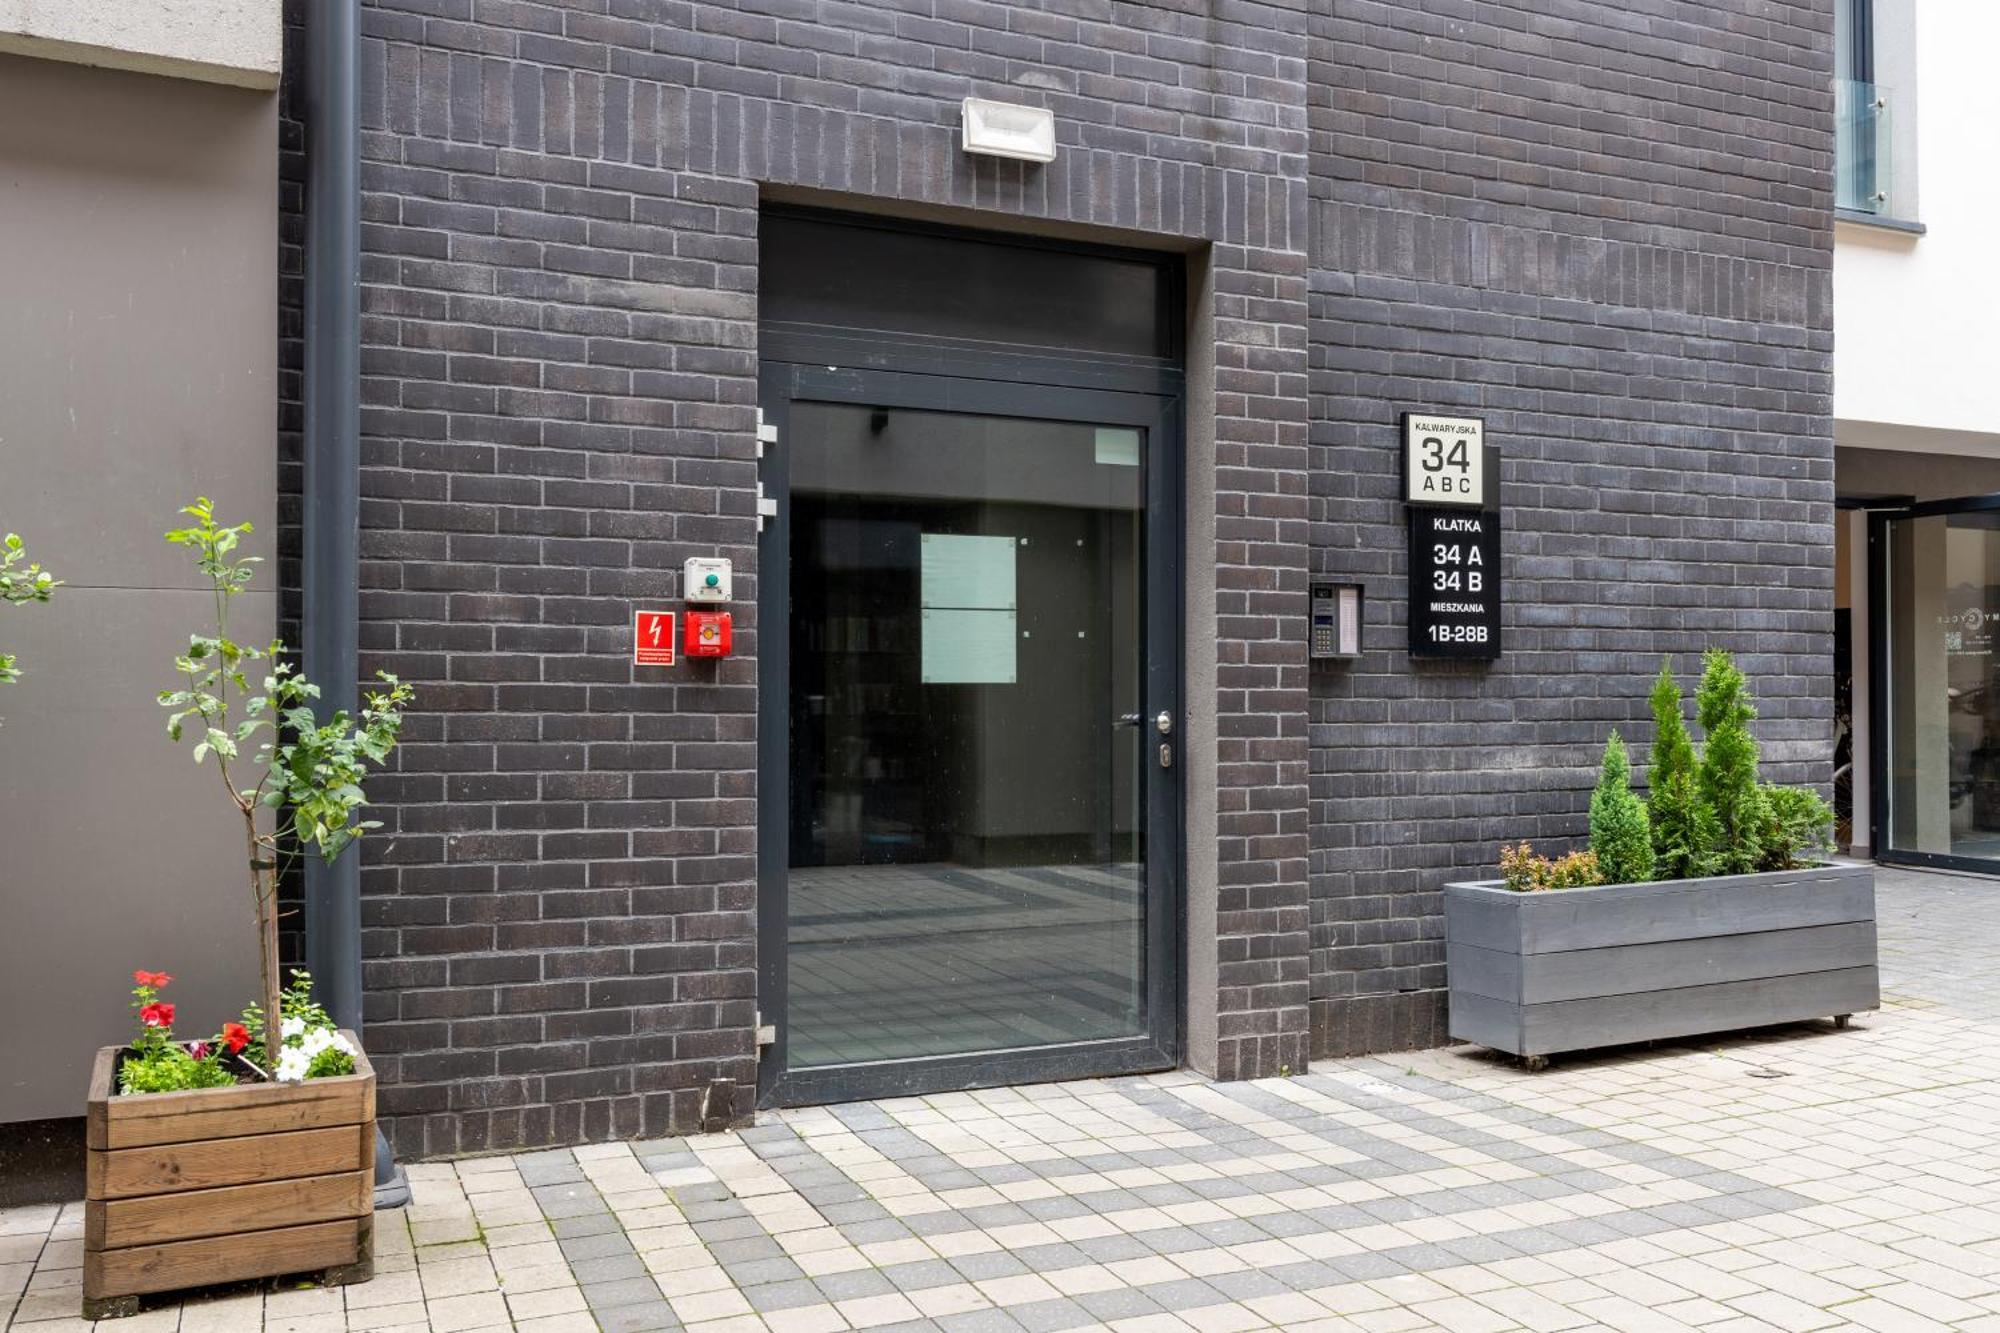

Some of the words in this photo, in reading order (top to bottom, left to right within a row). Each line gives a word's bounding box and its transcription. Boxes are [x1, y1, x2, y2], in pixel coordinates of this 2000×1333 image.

[1415, 422, 1477, 435] KALWARYJSKA
[1422, 437, 1470, 474] 34
[1423, 475, 1435, 491] A
[1441, 476, 1453, 493] B
[1459, 478, 1470, 493] C
[1433, 518, 1482, 533] KLATKA
[1433, 544, 1461, 565] 34
[1467, 545, 1483, 566] A
[1433, 570, 1461, 591] 34
[1468, 571, 1483, 592] B
[1430, 602, 1485, 613] MIESZKANIA
[1428, 625, 1488, 642] 1B-28B
